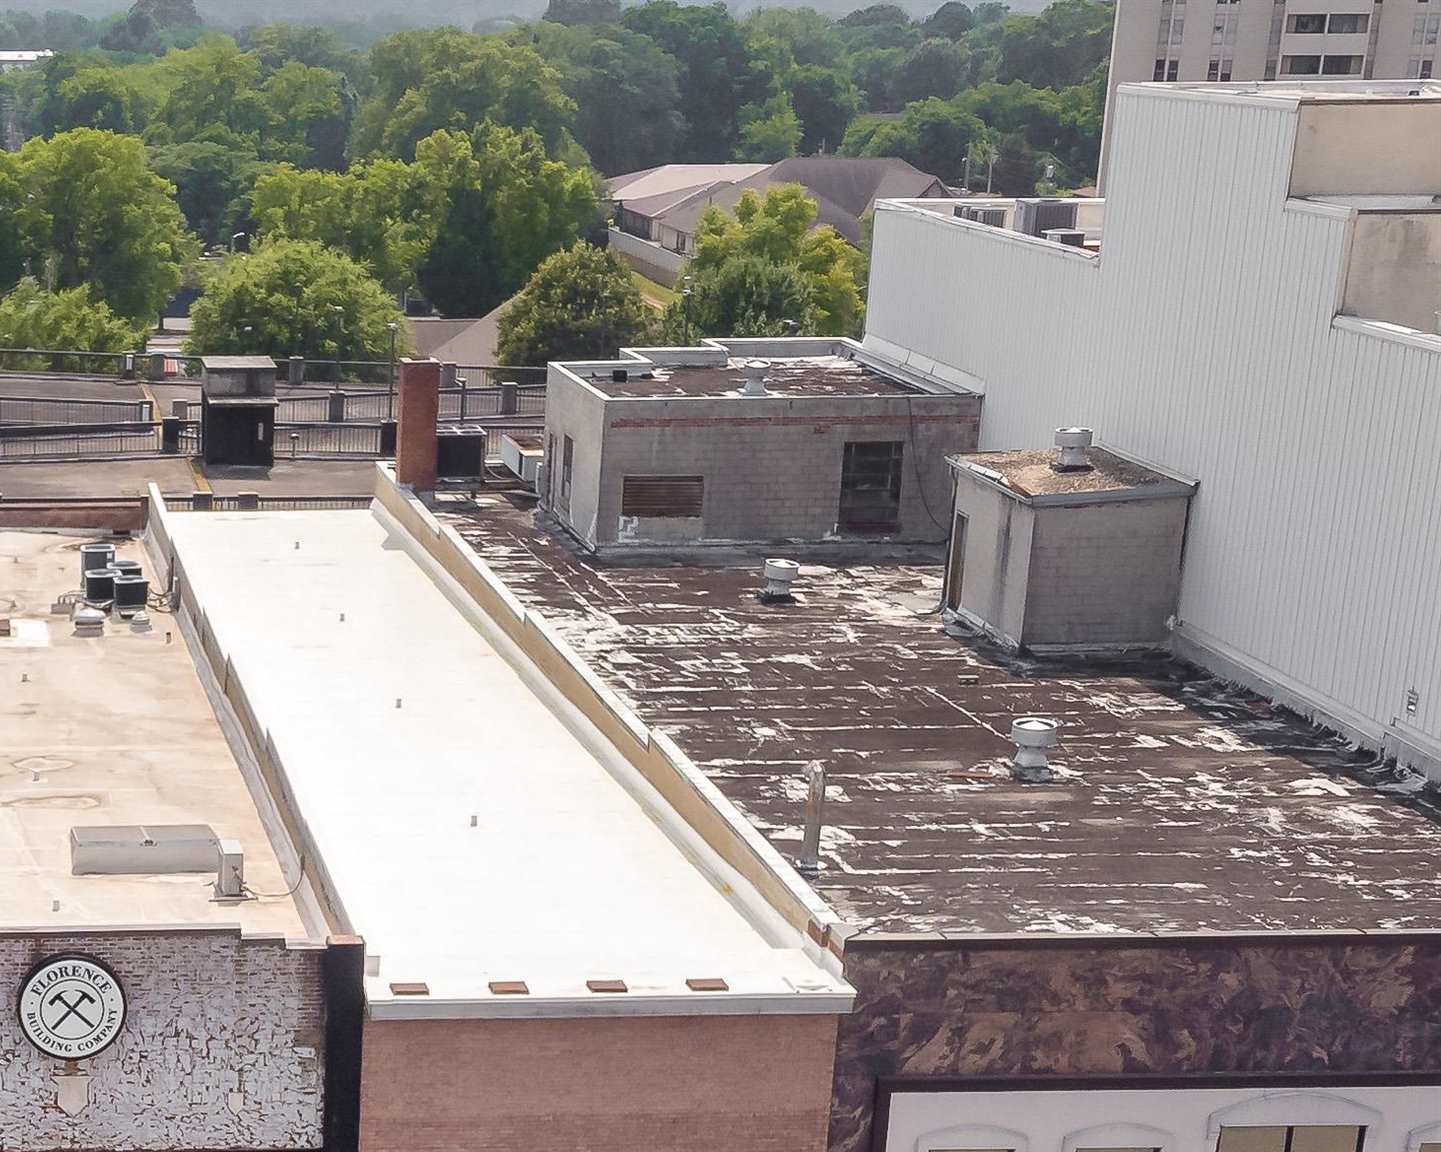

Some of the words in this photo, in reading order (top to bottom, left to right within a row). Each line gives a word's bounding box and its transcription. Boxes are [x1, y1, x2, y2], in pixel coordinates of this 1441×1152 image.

[30, 965, 113, 996] FLORENCE
[27, 1011, 73, 1052] BUILDING
[77, 1008, 118, 1051] COMPANY
